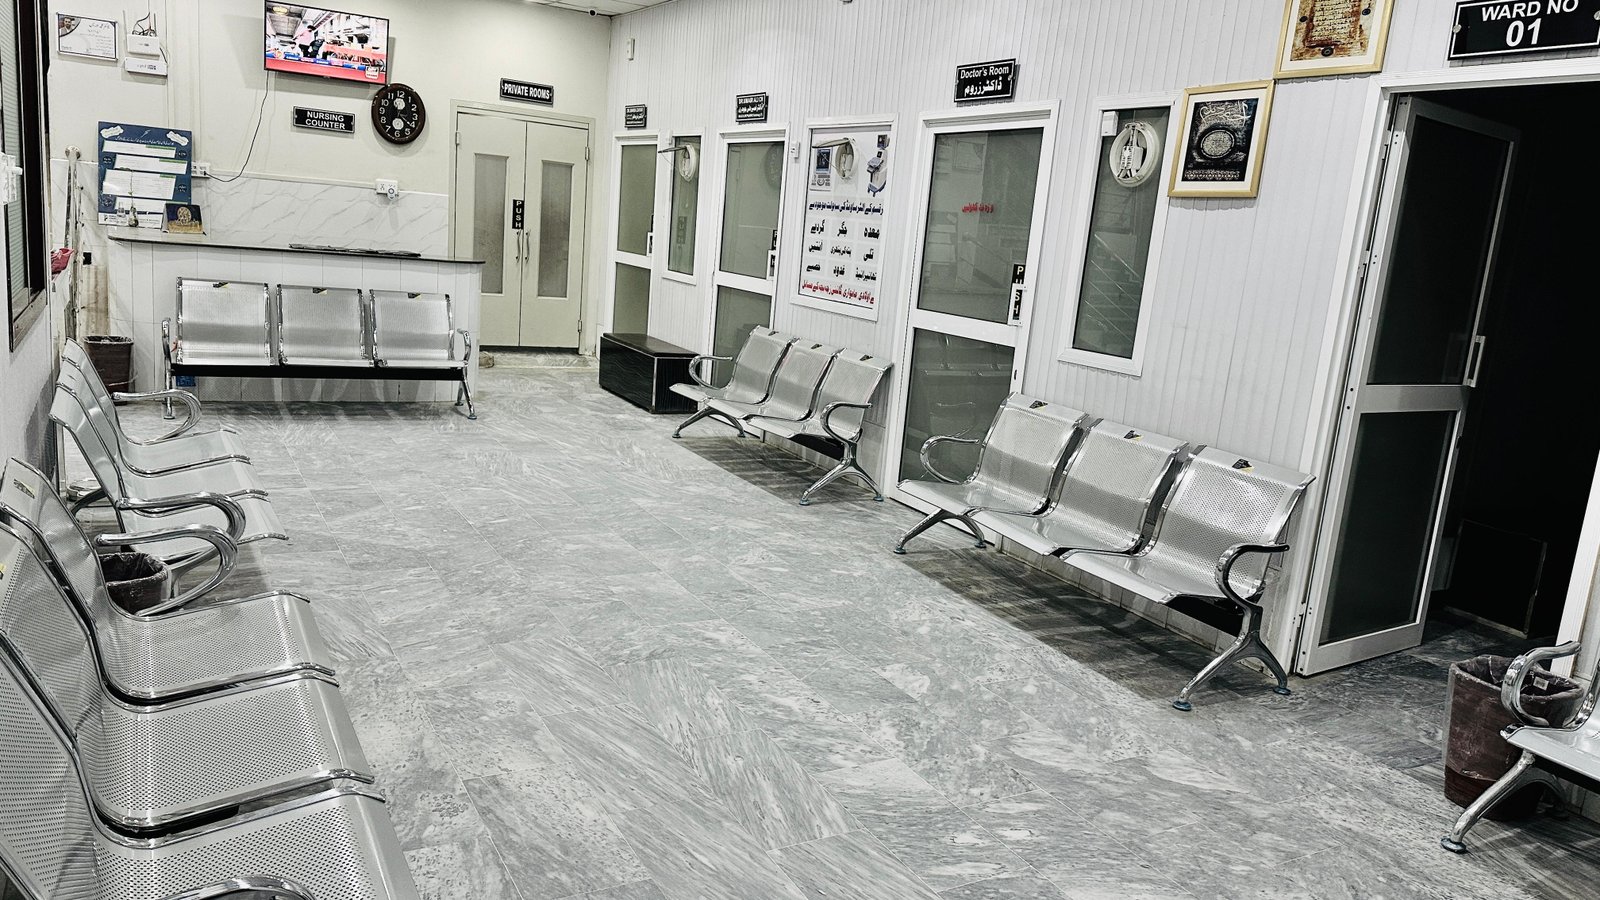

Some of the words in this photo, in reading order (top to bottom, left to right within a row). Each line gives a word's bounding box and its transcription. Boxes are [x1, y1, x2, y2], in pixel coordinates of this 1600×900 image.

[1482, 2, 1541, 21] WARD
[1546, 0, 1579, 14] NO
[1506, 18, 1542, 47] 01
[960, 68, 987, 79] Doctor's
[989, 66, 1009, 76] Room
[396, 90, 405, 98] 12
[504, 83, 528, 96] PRIVATE
[529, 87, 550, 100] ROOMS
[306, 110, 344, 122] NURSING
[412, 113, 418, 121] 3
[305, 119, 346, 130] COUNTER
[810, 219, 825, 234] گردے
[837, 221, 847, 237] جگر
[864, 227, 880, 239] معدہ
